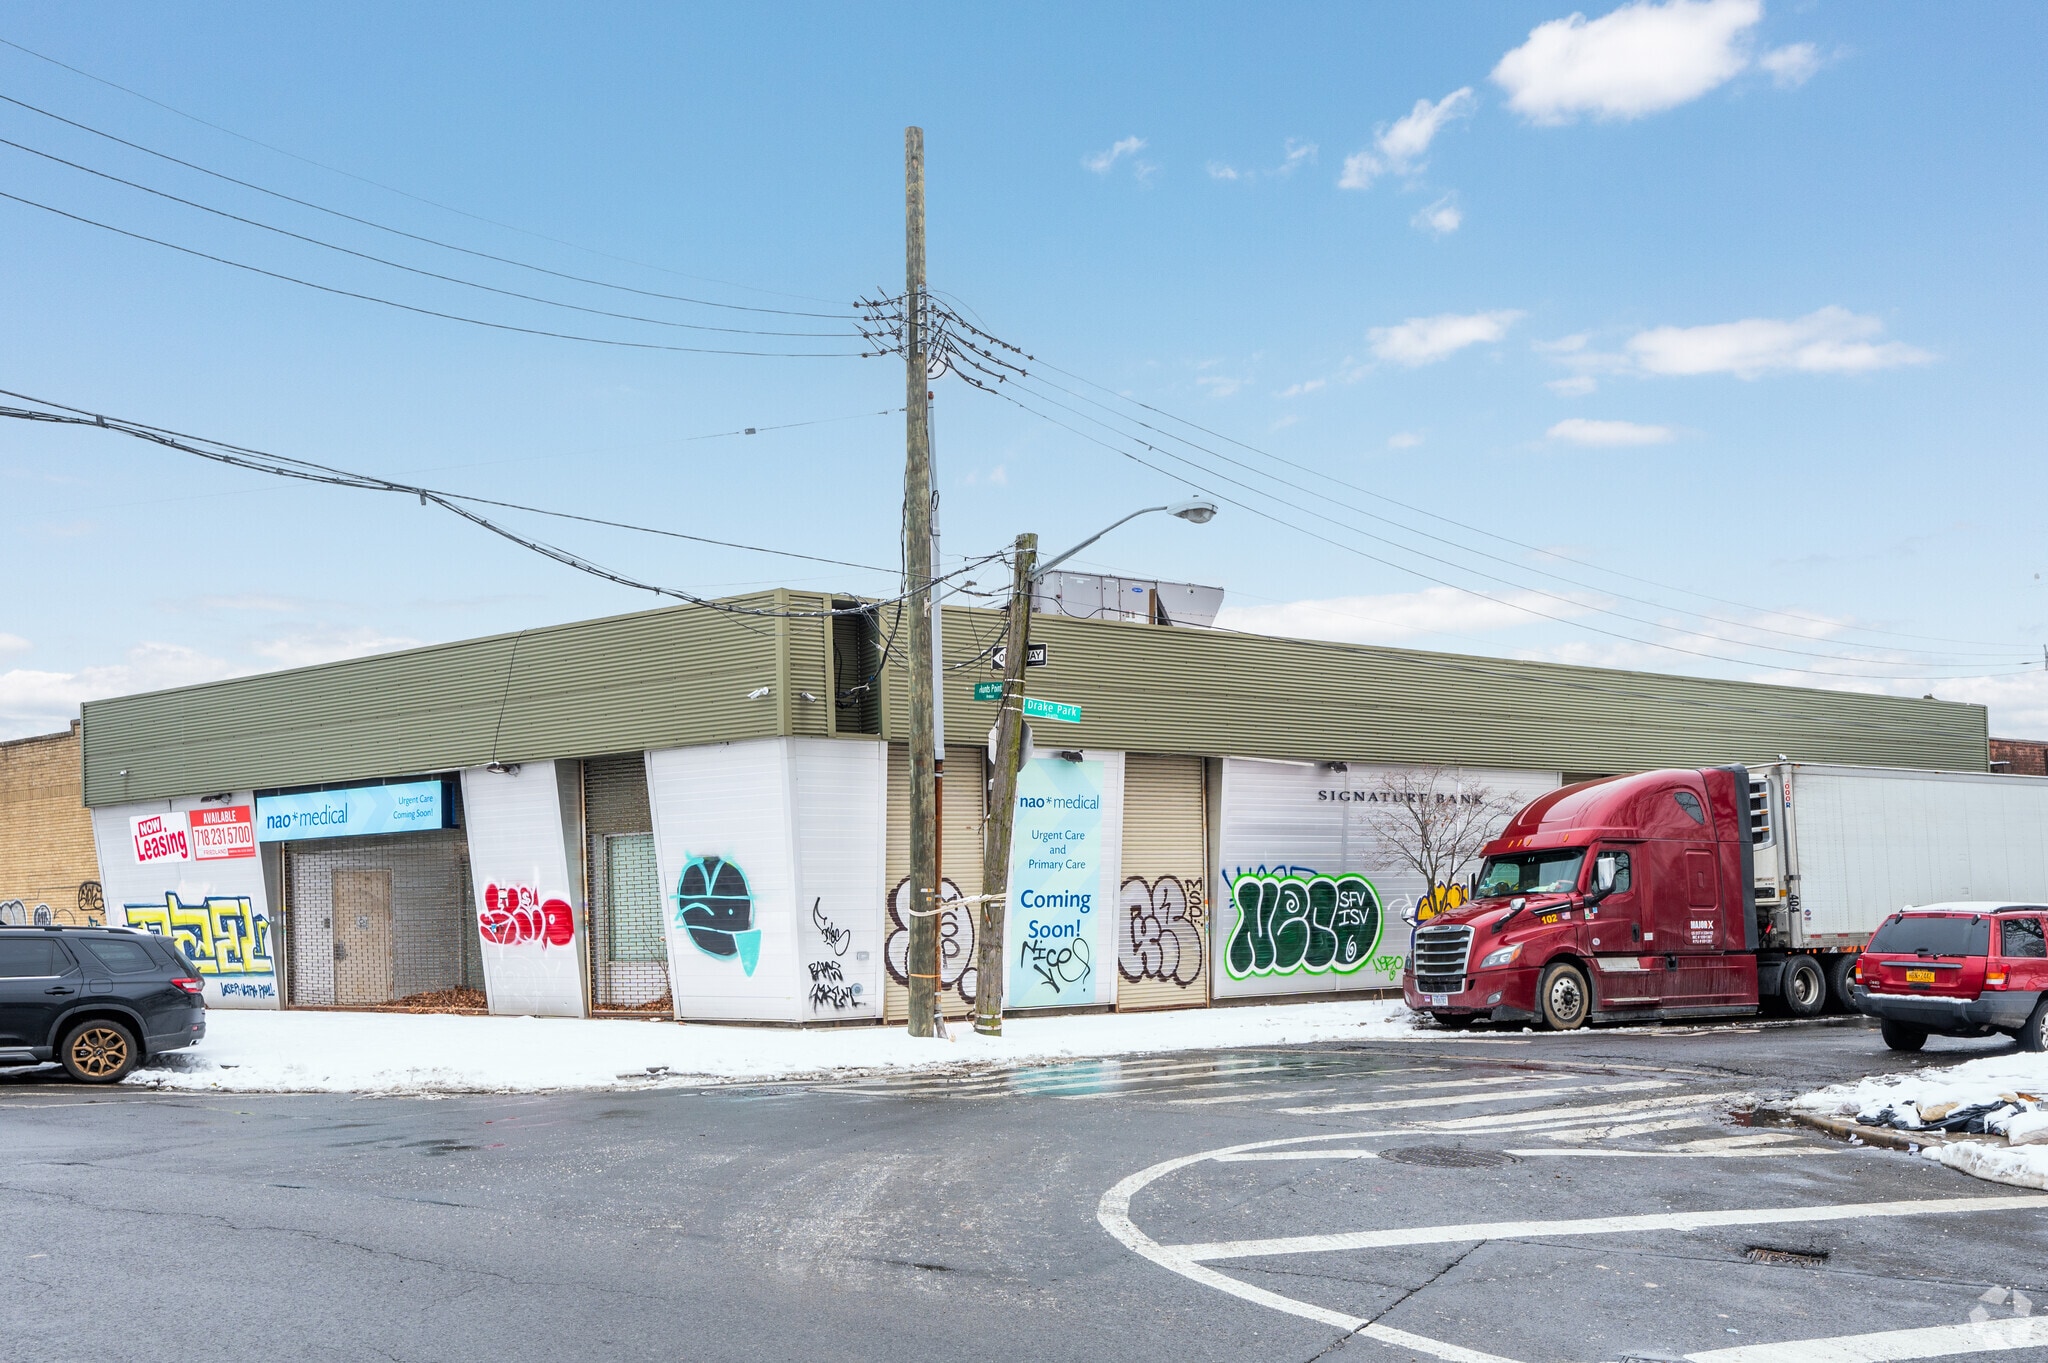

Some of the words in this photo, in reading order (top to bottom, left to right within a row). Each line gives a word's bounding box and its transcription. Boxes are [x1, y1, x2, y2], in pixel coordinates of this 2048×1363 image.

[991, 684, 1003, 693] Point
[1027, 700, 1054, 713] Drake
[1056, 706, 1077, 717] Park
[398, 796, 418, 806] Urgent
[419, 794, 433, 803] Care
[1318, 790, 1428, 804] SIGNATURE
[1436, 793, 1483, 804] BANK
[203, 810, 236, 825] AVAILABLE
[393, 810, 415, 820] Coming
[416, 808, 433, 818] Soon!
[140, 818, 161, 836] NOW
[134, 827, 188, 861] Leasing
[1031, 830, 1062, 843] Urgent
[1065, 830, 1085, 840] Care
[1049, 844, 1066, 854] and
[1028, 859, 1063, 872] Primary
[1066, 859, 1086, 869] Care
[1021, 889, 1091, 914] Coming
[1338, 891, 1366, 908] SFV
[1789, 894, 1800, 914] 404
[1338, 907, 1369, 926] ISV
[1541, 914, 1558, 924] 102
[1028, 919, 1081, 938] Soon!
